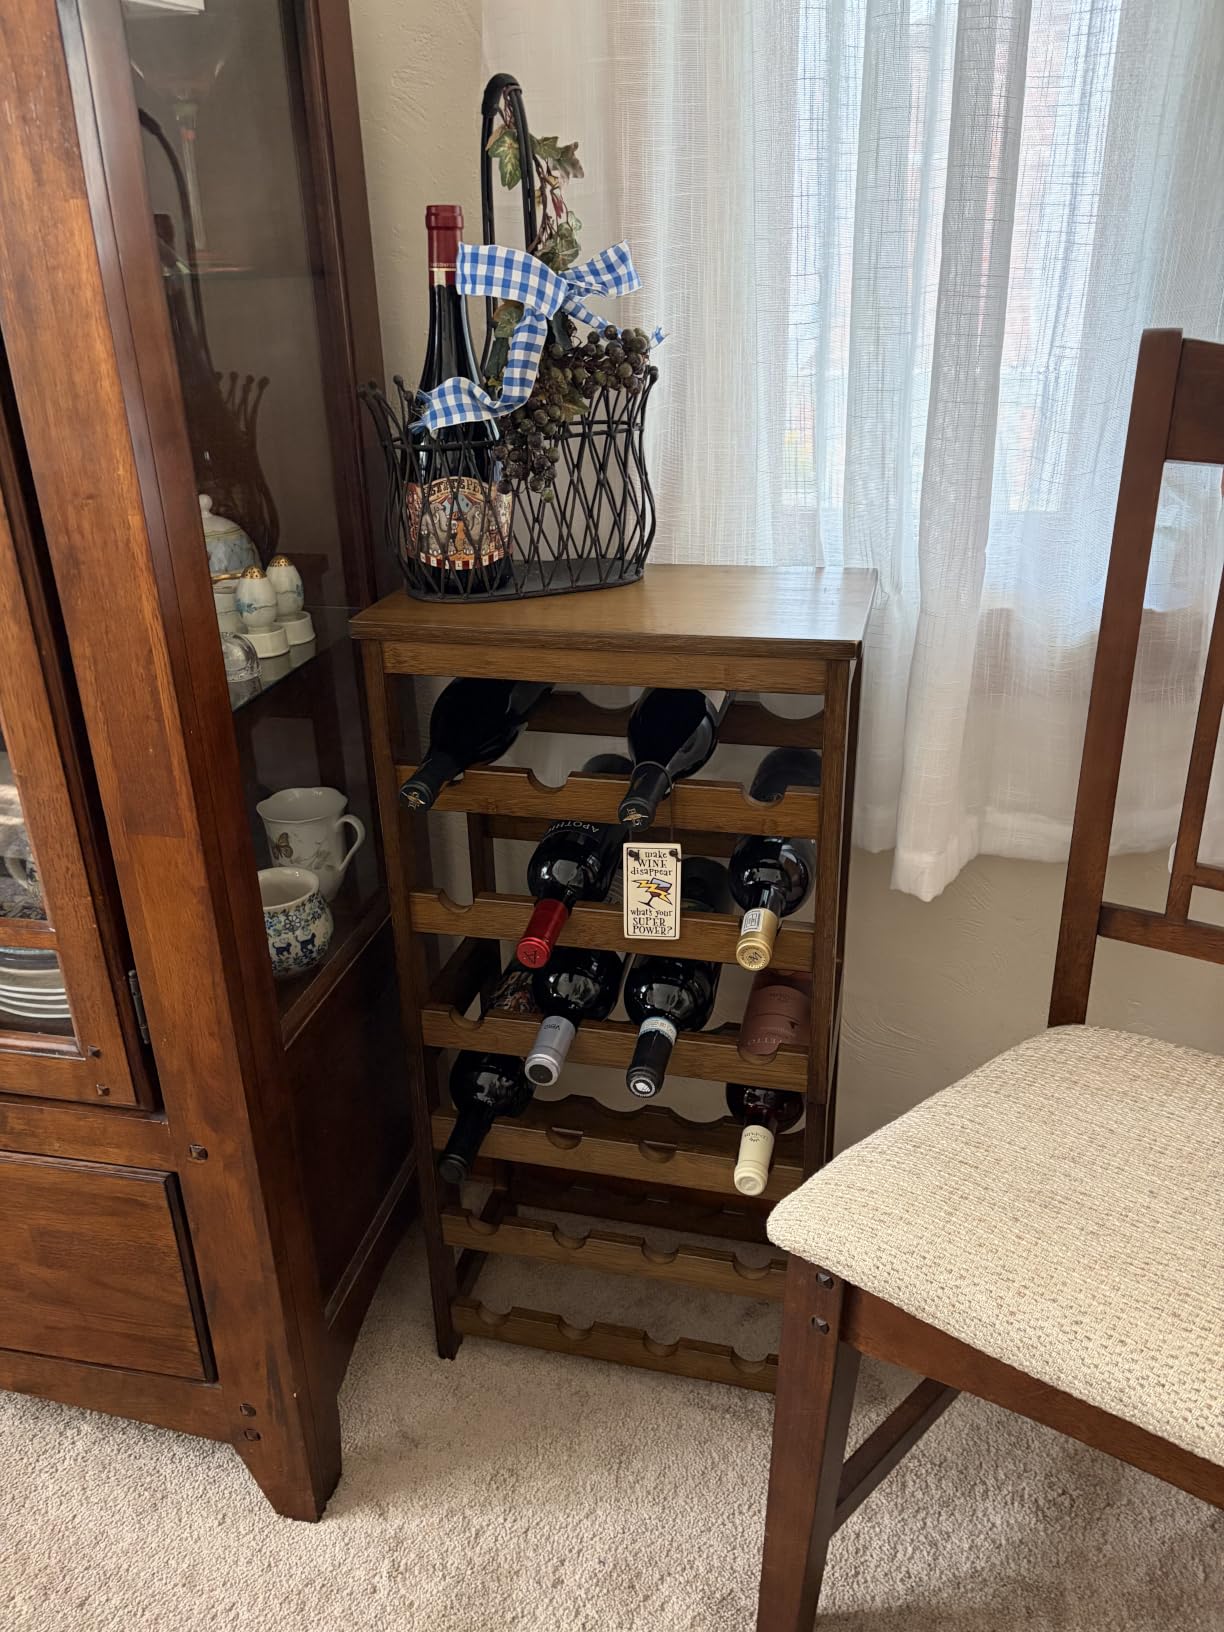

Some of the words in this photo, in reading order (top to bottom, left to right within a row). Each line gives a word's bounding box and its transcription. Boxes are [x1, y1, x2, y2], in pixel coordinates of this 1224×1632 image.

[644, 850, 668, 859] make
[638, 859, 668, 869] WINE
[630, 867, 673, 877] disappear
[630, 908, 653, 917] what's
[655, 909, 673, 917] your
[632, 917, 666, 927] SUPER
[632, 925, 673, 935] POWER?
